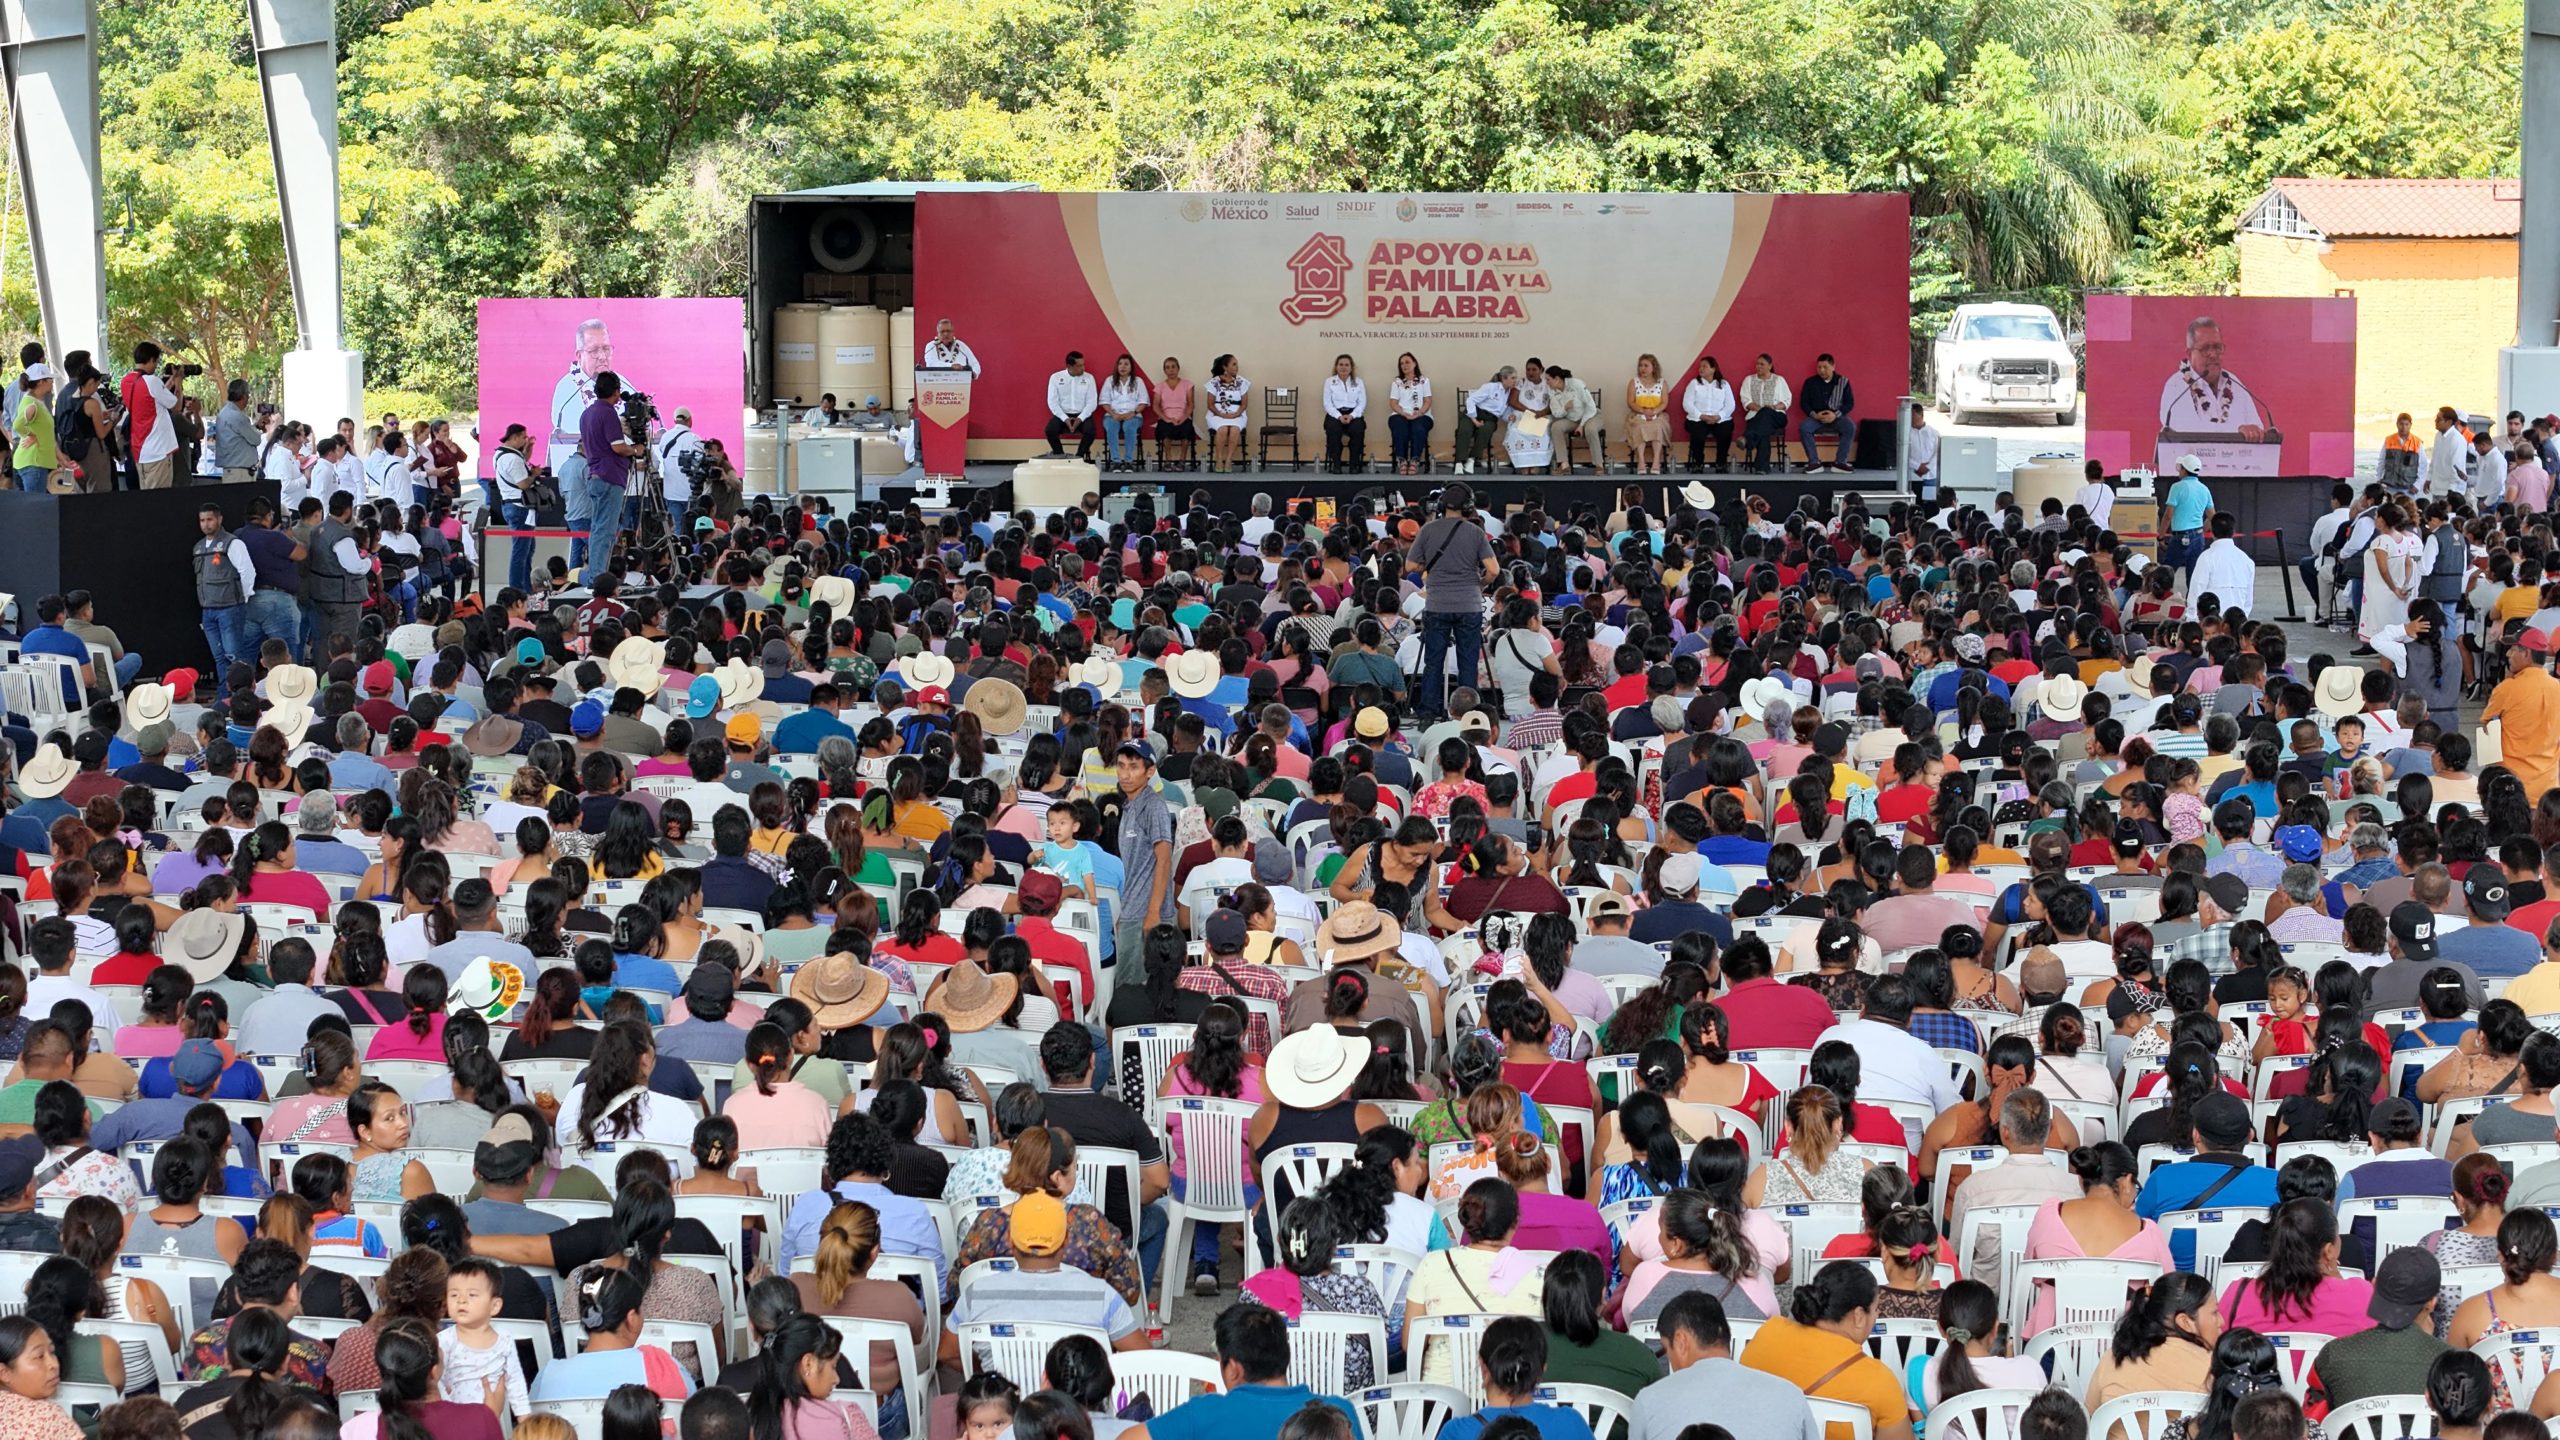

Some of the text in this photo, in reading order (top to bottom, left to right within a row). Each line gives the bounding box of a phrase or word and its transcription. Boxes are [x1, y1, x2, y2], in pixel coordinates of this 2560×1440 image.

[1211, 198, 1269, 208] Gobierno de
[1336, 201, 1376, 212] SNDIF
[1475, 202, 1489, 210] DIF
[1516, 202, 1553, 210] SEDESOL
[1562, 202, 1575, 210] PC
[1211, 207, 1269, 221] México
[1285, 206, 1320, 218] Salud
[1368, 243, 1532, 265] APOYO A LA
[1368, 269, 1545, 292] FAMILIA Y LA
[1368, 296, 1524, 318] PALABRA
[1319, 331, 1362, 340] PAPANTLA,
[1409, 331, 1418, 339] 25
[1419, 331, 1430, 339] DE
[1431, 331, 1480, 339] SEPTIEMBRE
[1481, 331, 1492, 339] DE
[1493, 331, 1510, 339] 2025
[577, 607, 609, 633] 24
